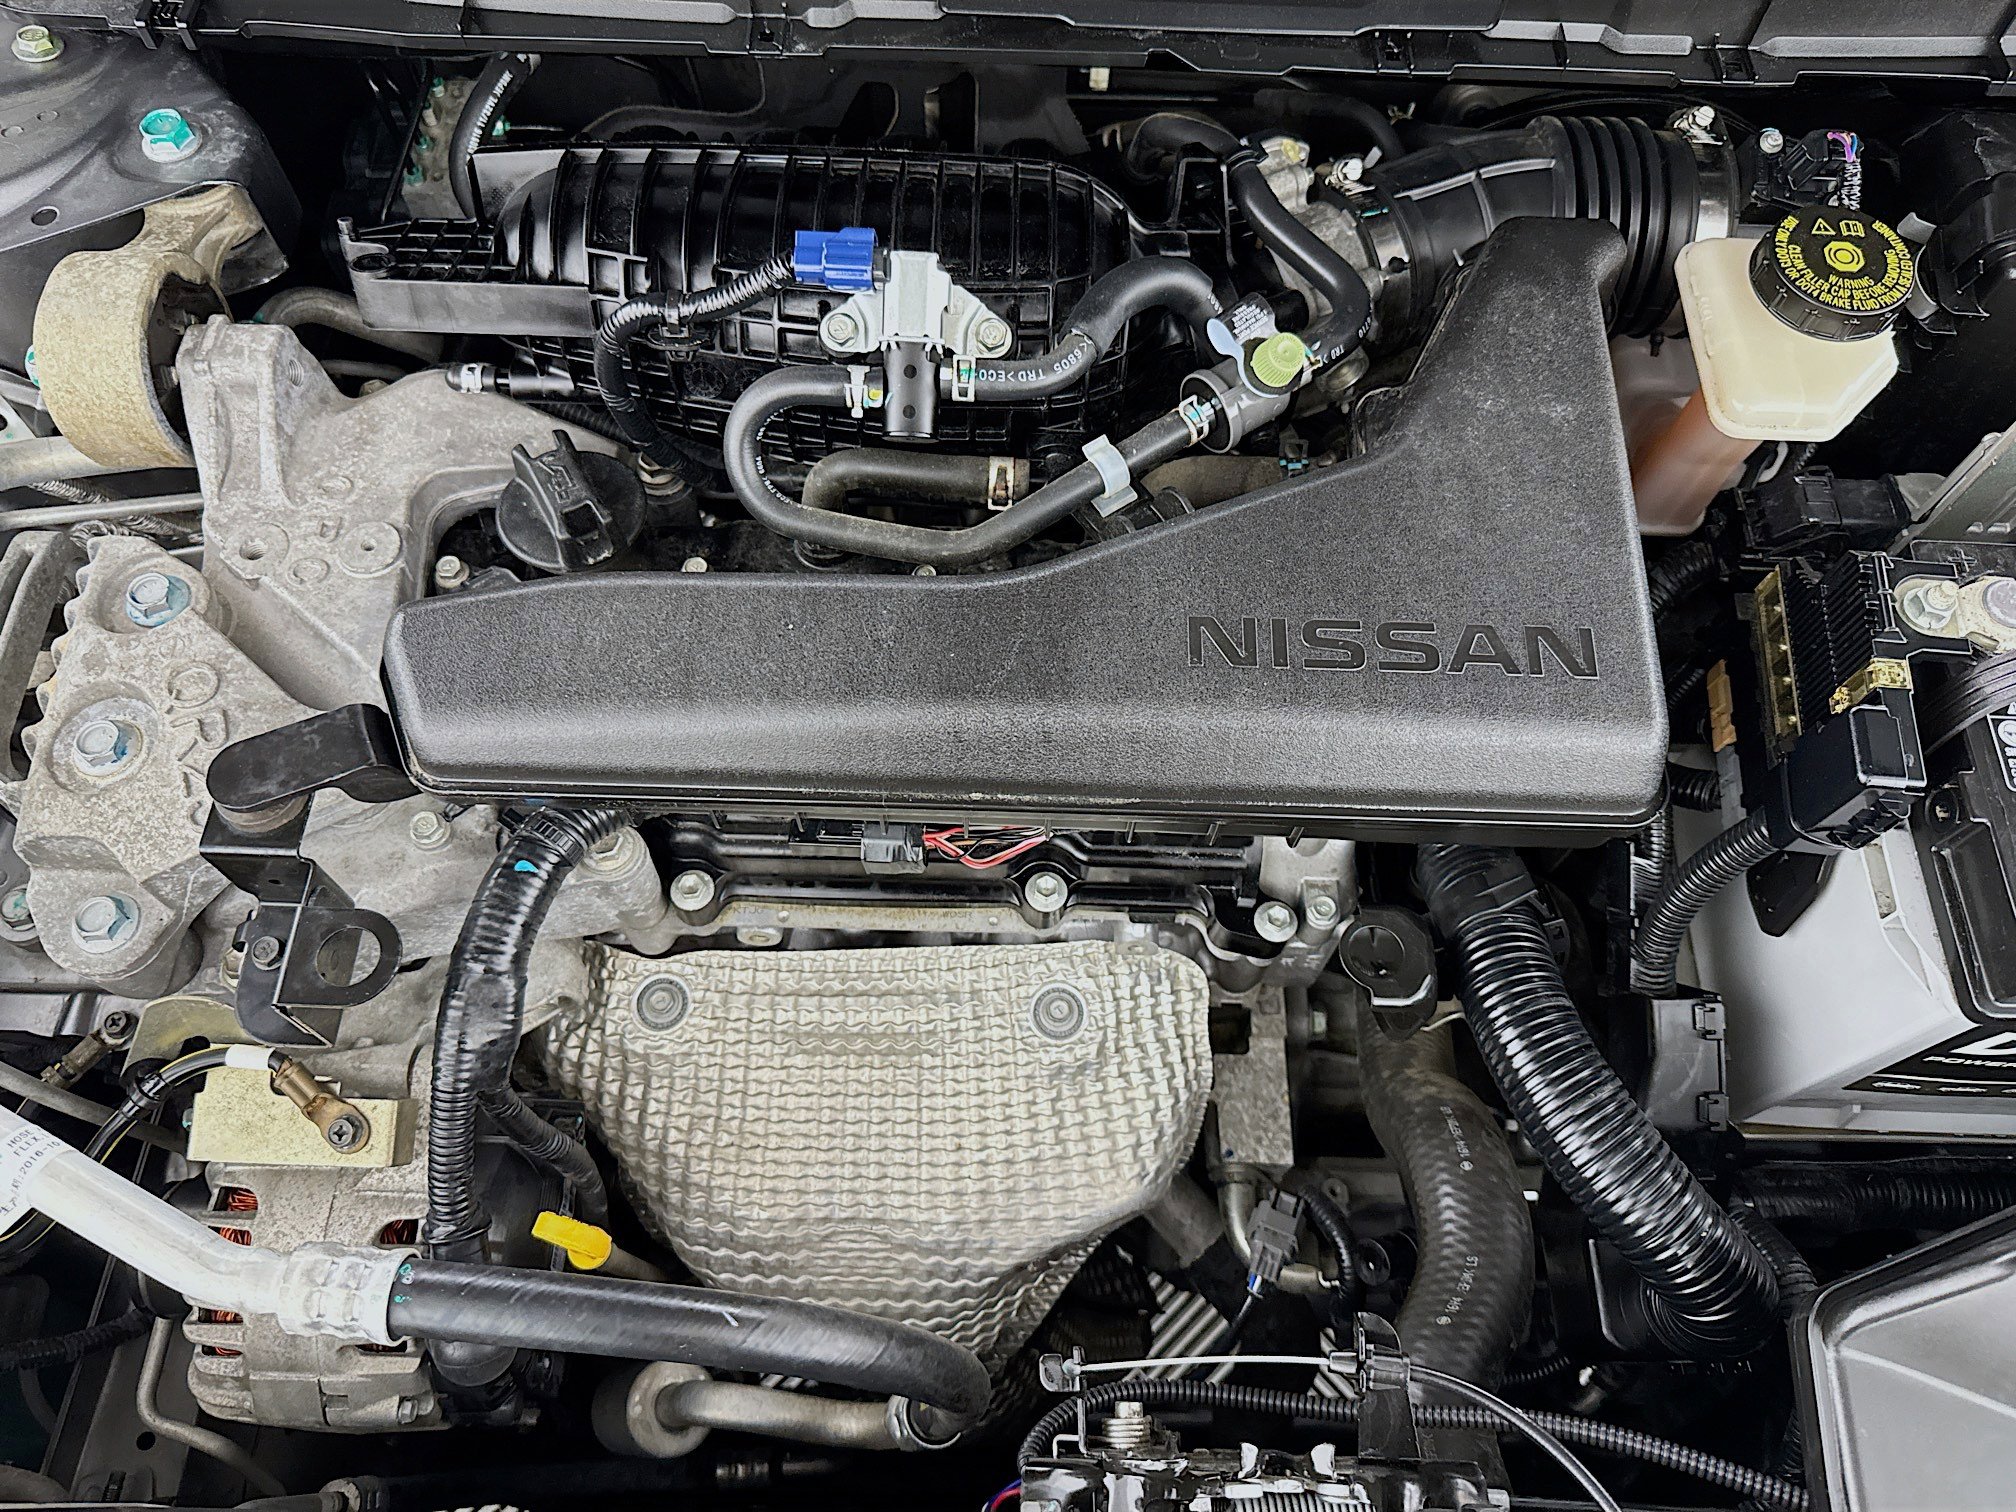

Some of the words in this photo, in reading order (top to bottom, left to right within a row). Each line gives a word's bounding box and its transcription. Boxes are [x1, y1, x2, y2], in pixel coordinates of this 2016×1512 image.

[1780, 215, 1799, 231] USE
[1775, 228, 1791, 247] ONLY
[1871, 219, 1911, 260] CONTAINER
[1785, 267, 1801, 280] OR
[1788, 244, 1808, 270] CLEAN
[1800, 268, 1831, 292] FILLER
[1831, 286, 1851, 299] CAP
[1852, 282, 1890, 300] BEFORE
[1882, 248, 1901, 288] REMOVING
[1828, 274, 1875, 289] WARNING
[1898, 260, 1914, 288] SEALED
[1795, 278, 1821, 298] DOT4
[1895, 284, 1909, 295] A
[1819, 291, 1853, 309] BRAKE
[1853, 298, 1881, 311] FLUID
[1877, 288, 1904, 308] FROM
[1188, 616, 1600, 680] NISSAN
